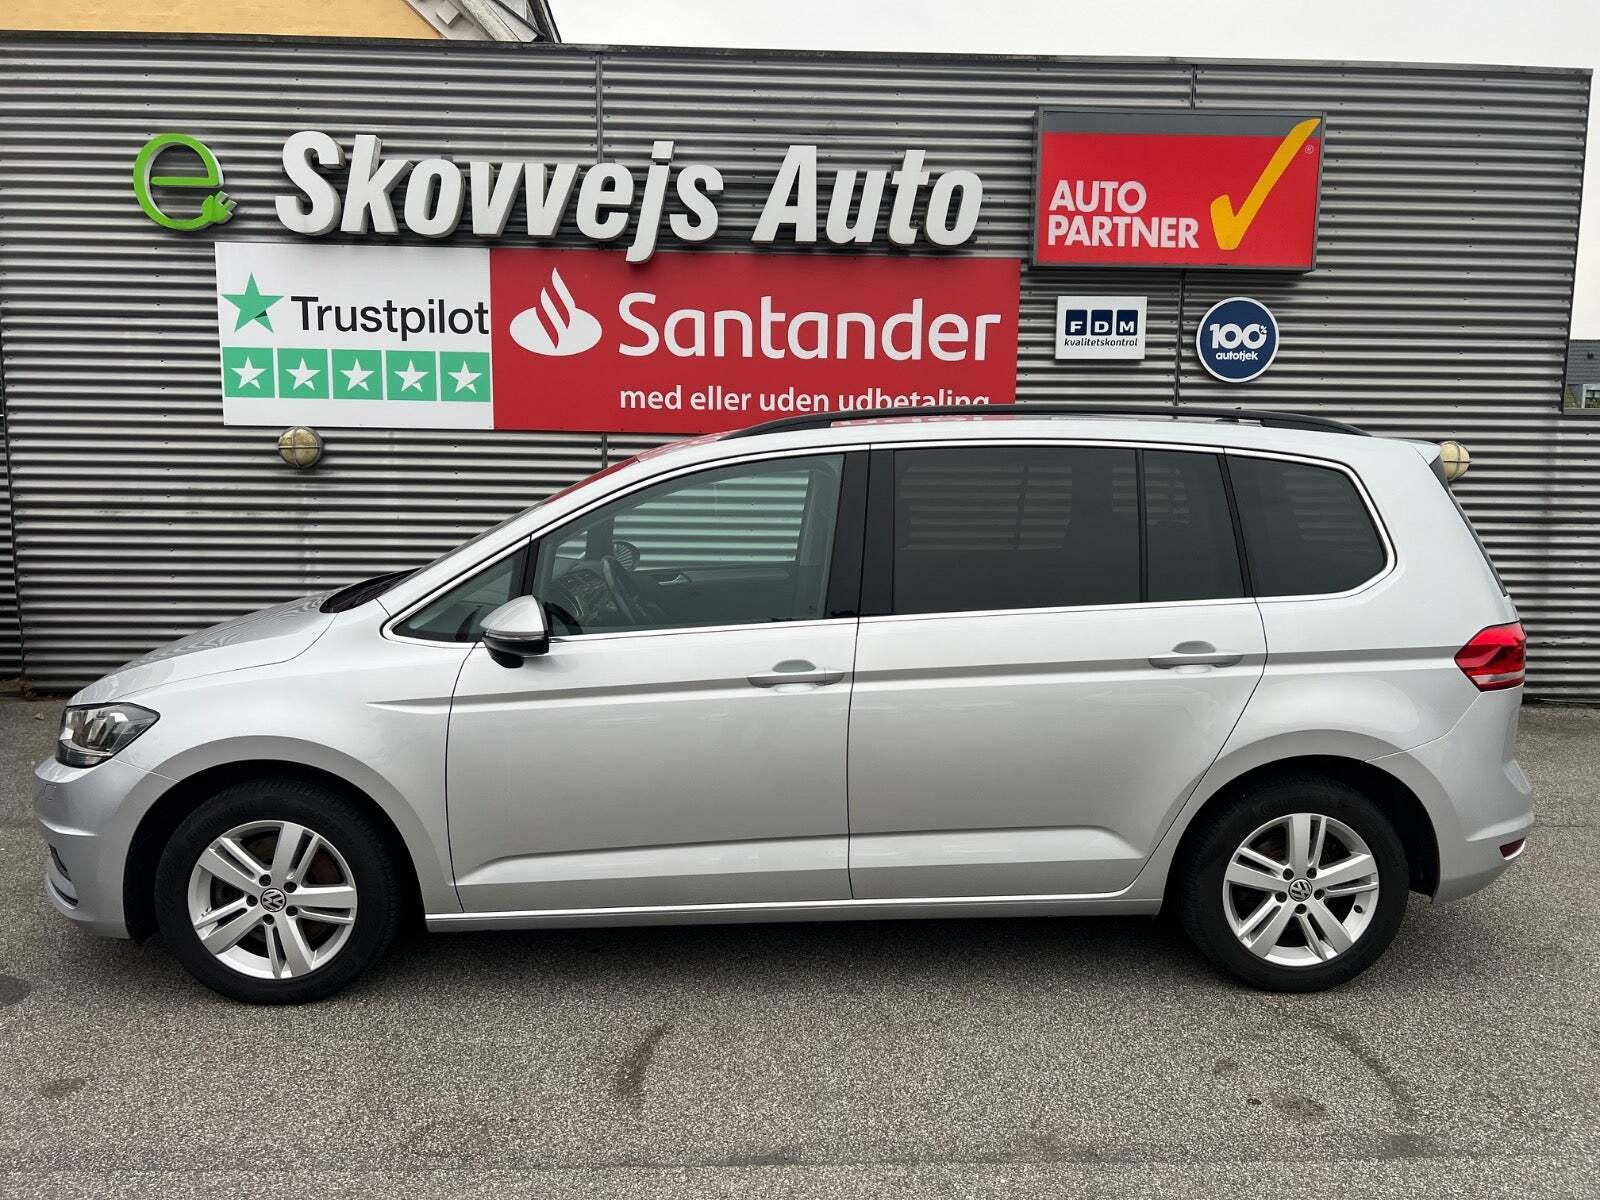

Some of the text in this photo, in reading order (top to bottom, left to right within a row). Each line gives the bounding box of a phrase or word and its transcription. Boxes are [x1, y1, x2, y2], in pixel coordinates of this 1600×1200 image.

[275, 130, 724, 265] Skovvejs
[751, 144, 984, 247] Auto
[1049, 179, 1147, 214] AUTO
[1047, 214, 1200, 249] PARTNER
[291, 295, 490, 341] Trustpilot
[617, 292, 1001, 361] Santander
[1069, 319, 1136, 334] FDM
[1064, 338, 1138, 347] kvalitetskontrol
[1215, 351, 1258, 362] autotjek
[620, 385, 682, 410] med
[690, 385, 751, 411] eller
[759, 387, 829, 412] uden
